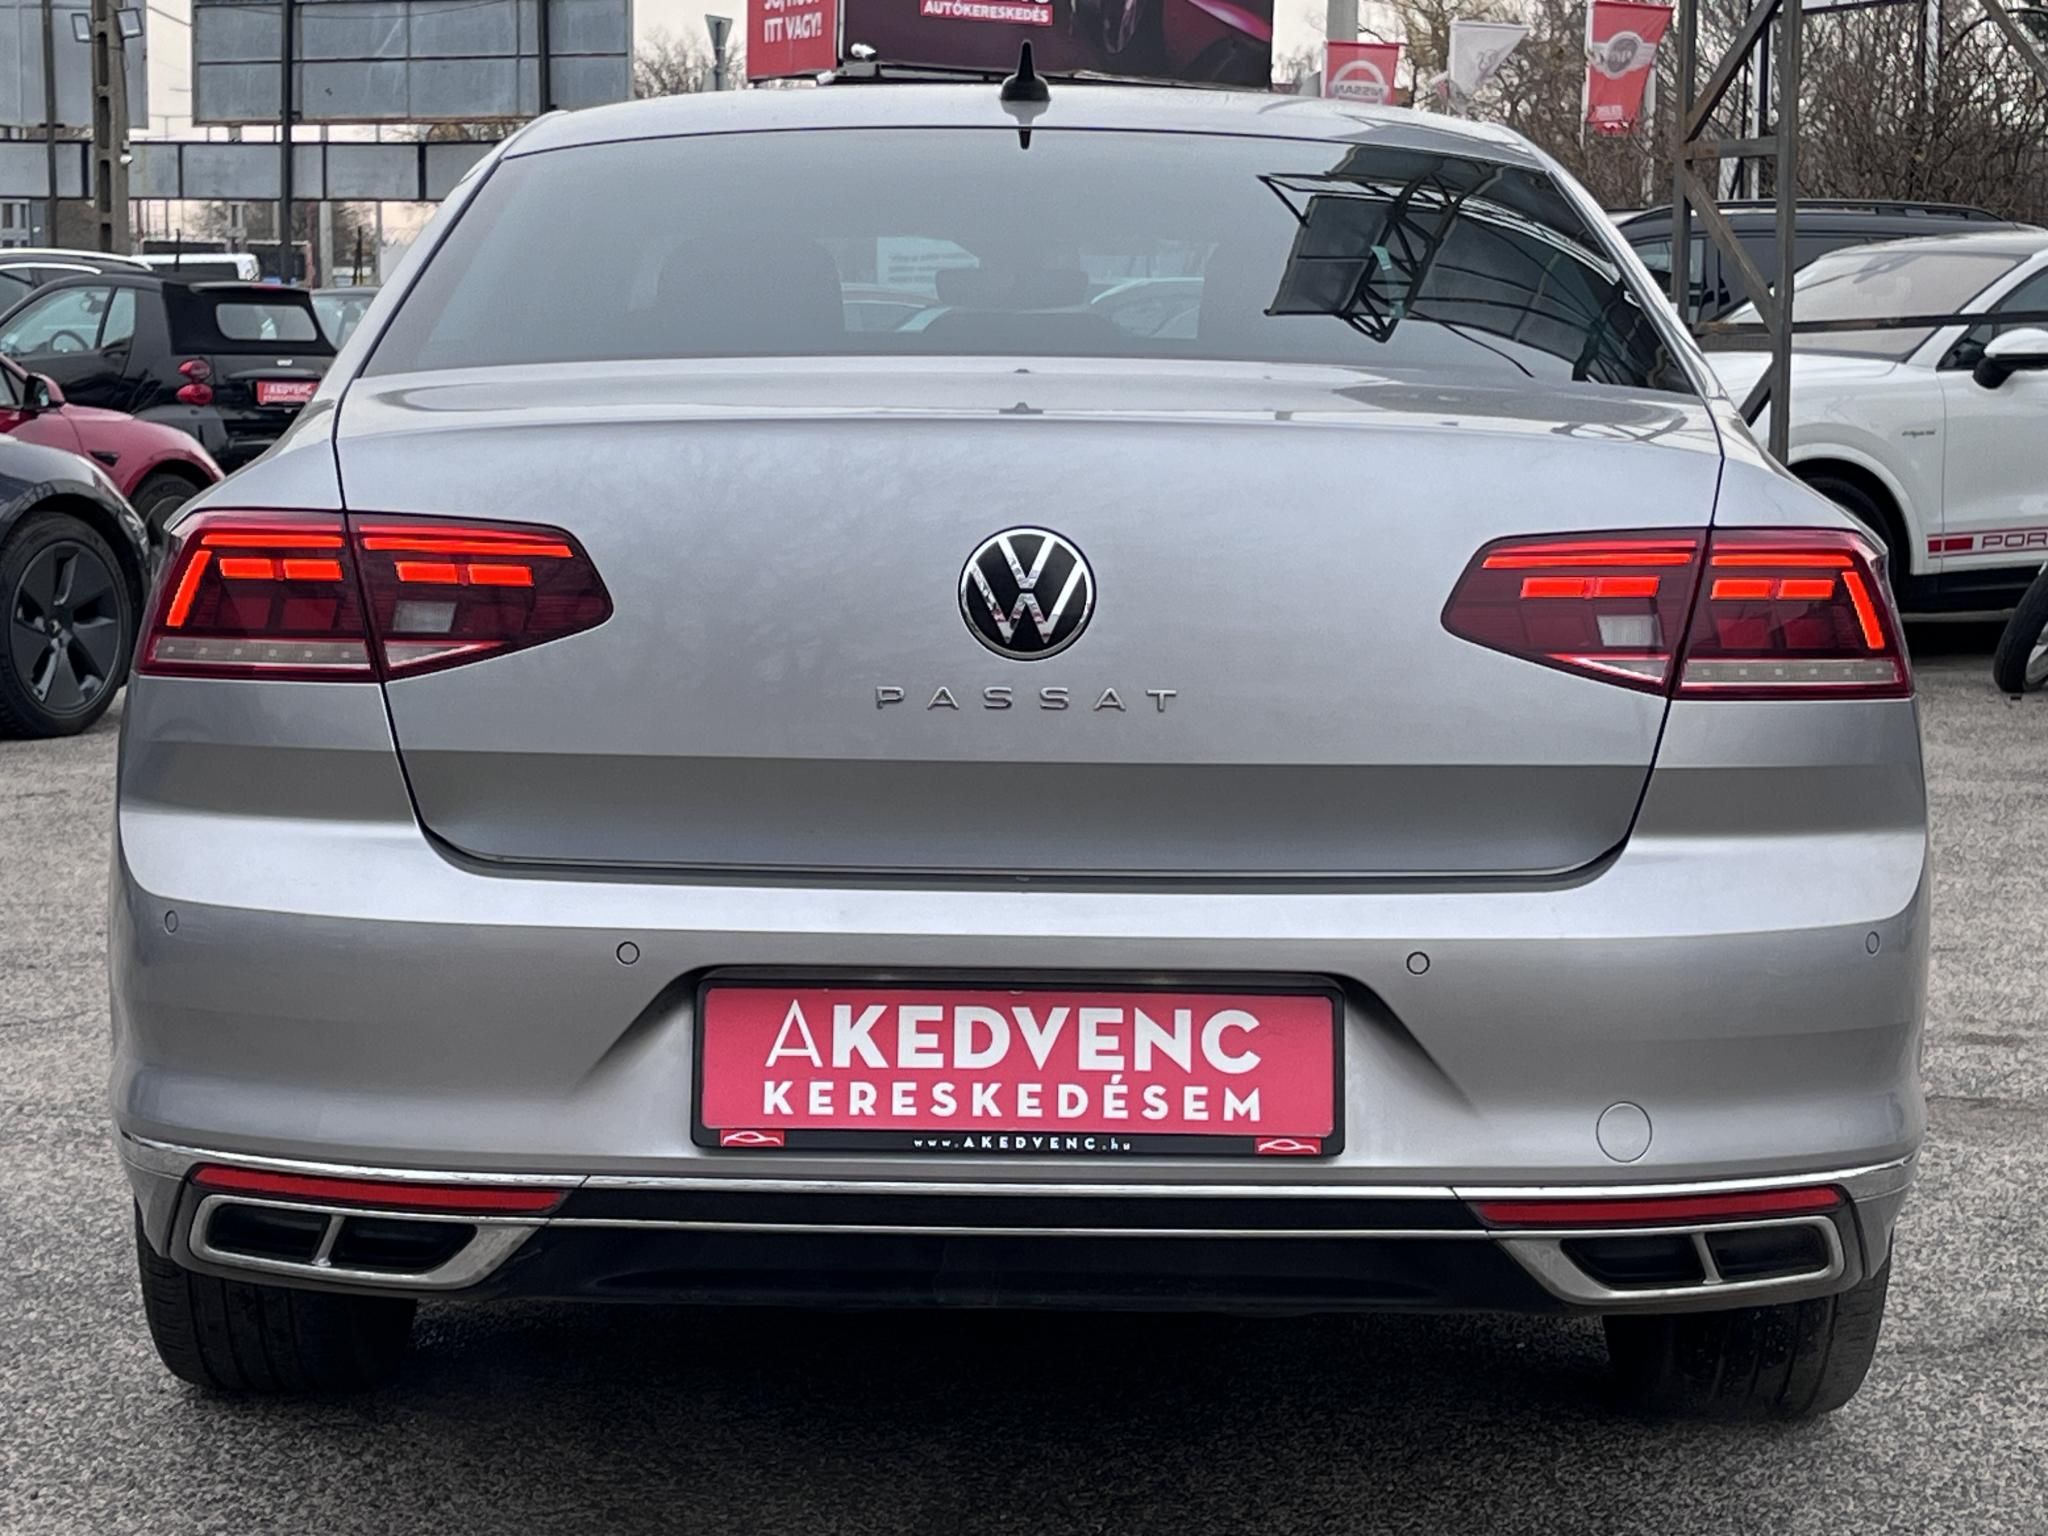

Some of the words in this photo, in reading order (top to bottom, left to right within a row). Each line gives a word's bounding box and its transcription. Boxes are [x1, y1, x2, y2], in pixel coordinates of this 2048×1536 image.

[924, 1, 1049, 23] AUTÓKERESKEDÉS
[764, 17, 783, 43] ITT
[785, 12, 822, 40] VAGY!
[875, 686, 1177, 712] PASSAT
[765, 1000, 1262, 1074] AKEDVENC
[763, 1075, 1261, 1122] KERESKEDÉSEM
[914, 1136, 1131, 1150] www.AKEDVENC.hu
